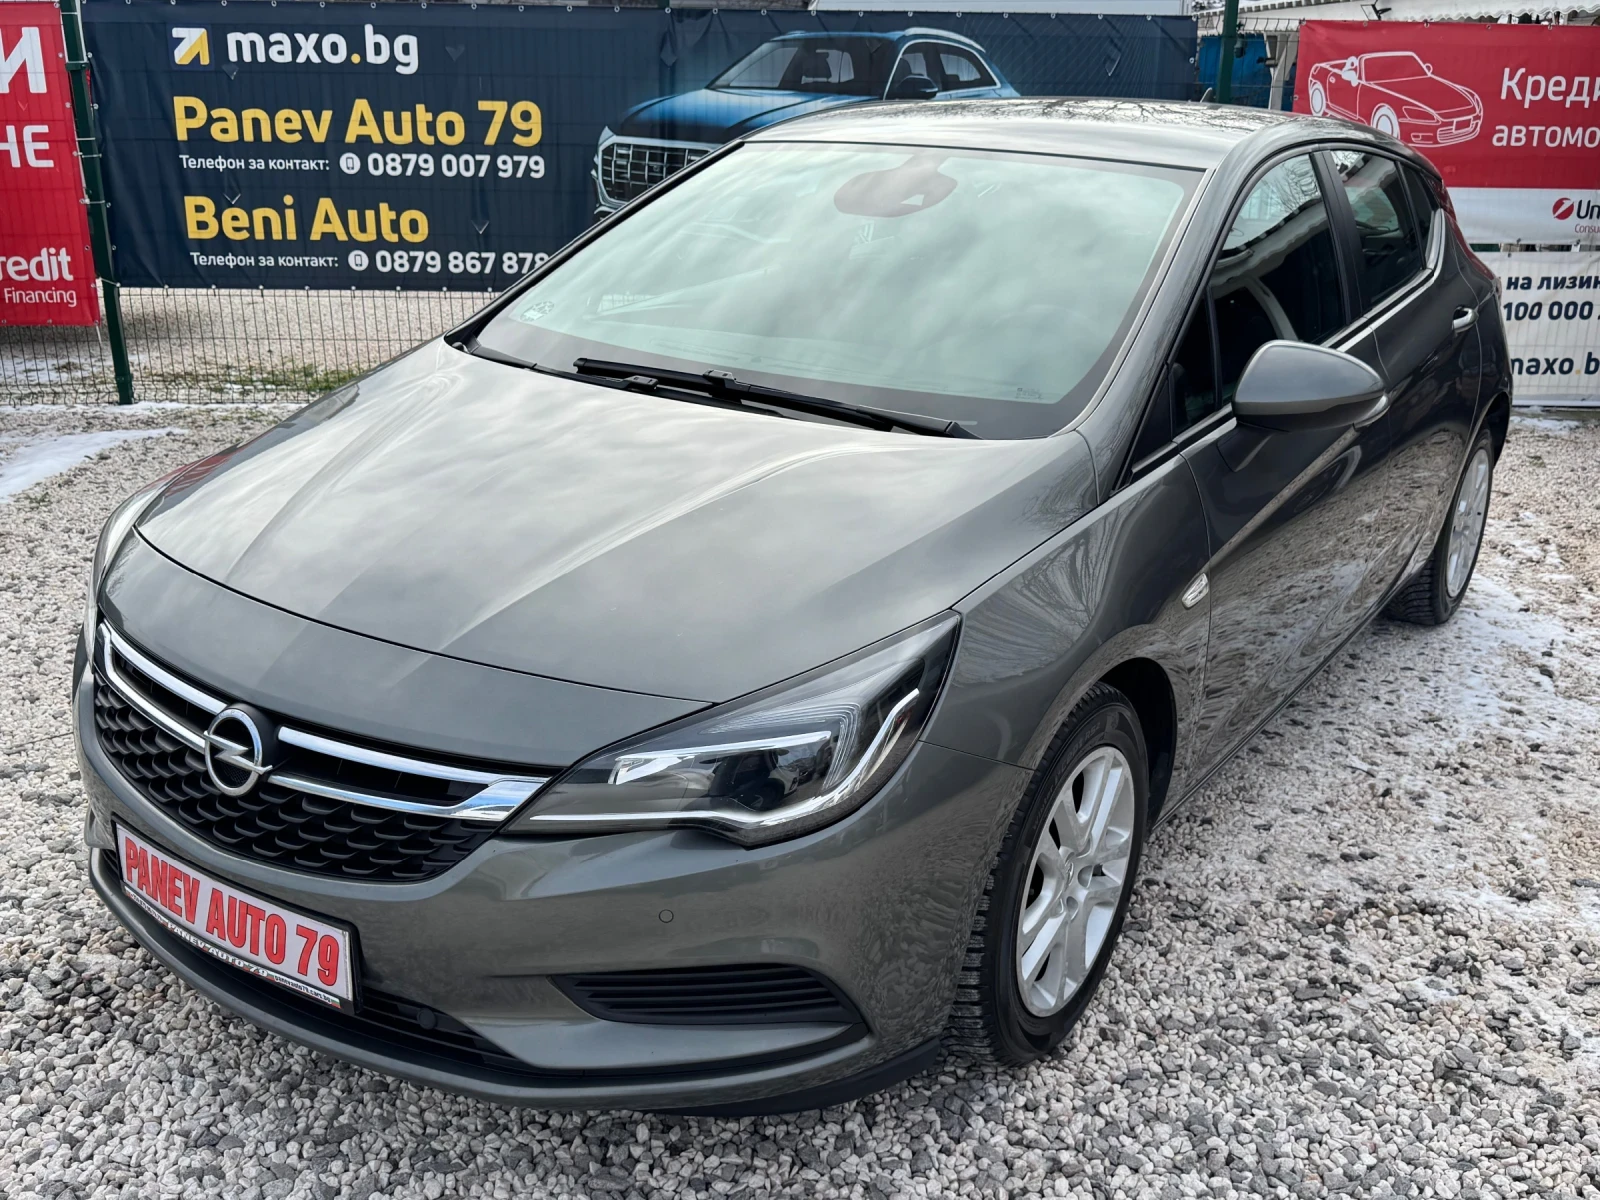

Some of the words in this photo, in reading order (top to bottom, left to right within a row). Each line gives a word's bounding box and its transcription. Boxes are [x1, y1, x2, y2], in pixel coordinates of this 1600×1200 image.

[226, 23, 419, 75] maxo.bg
[173, 96, 333, 143] Panev
[345, 98, 465, 146] Auto
[477, 100, 542, 147] 79
[179, 154, 246, 173] Телефон
[248, 158, 265, 170] за
[268, 158, 330, 171] контакт:
[367, 153, 434, 177] 0879
[441, 154, 491, 178] 007
[496, 155, 545, 179] 979
[183, 194, 297, 241] Beni
[309, 197, 429, 243] Auto
[190, 252, 255, 269] Телефон
[258, 256, 275, 267] за
[277, 256, 339, 267] контакт:
[375, 250, 441, 274] 0879
[448, 251, 496, 274] 867
[4, 286, 77, 308] Financing
[1506, 276, 1532, 290] на
[1503, 301, 1543, 321] 100
[1548, 300, 1594, 320] 000
[125, 836, 200, 925] PANEV
[206, 887, 287, 965] AUTO
[296, 924, 340, 987] 79
[167, 922, 205, 949] PANEV
[208, 946, 244, 968] AUTO
[248, 964, 268, 978] 79
